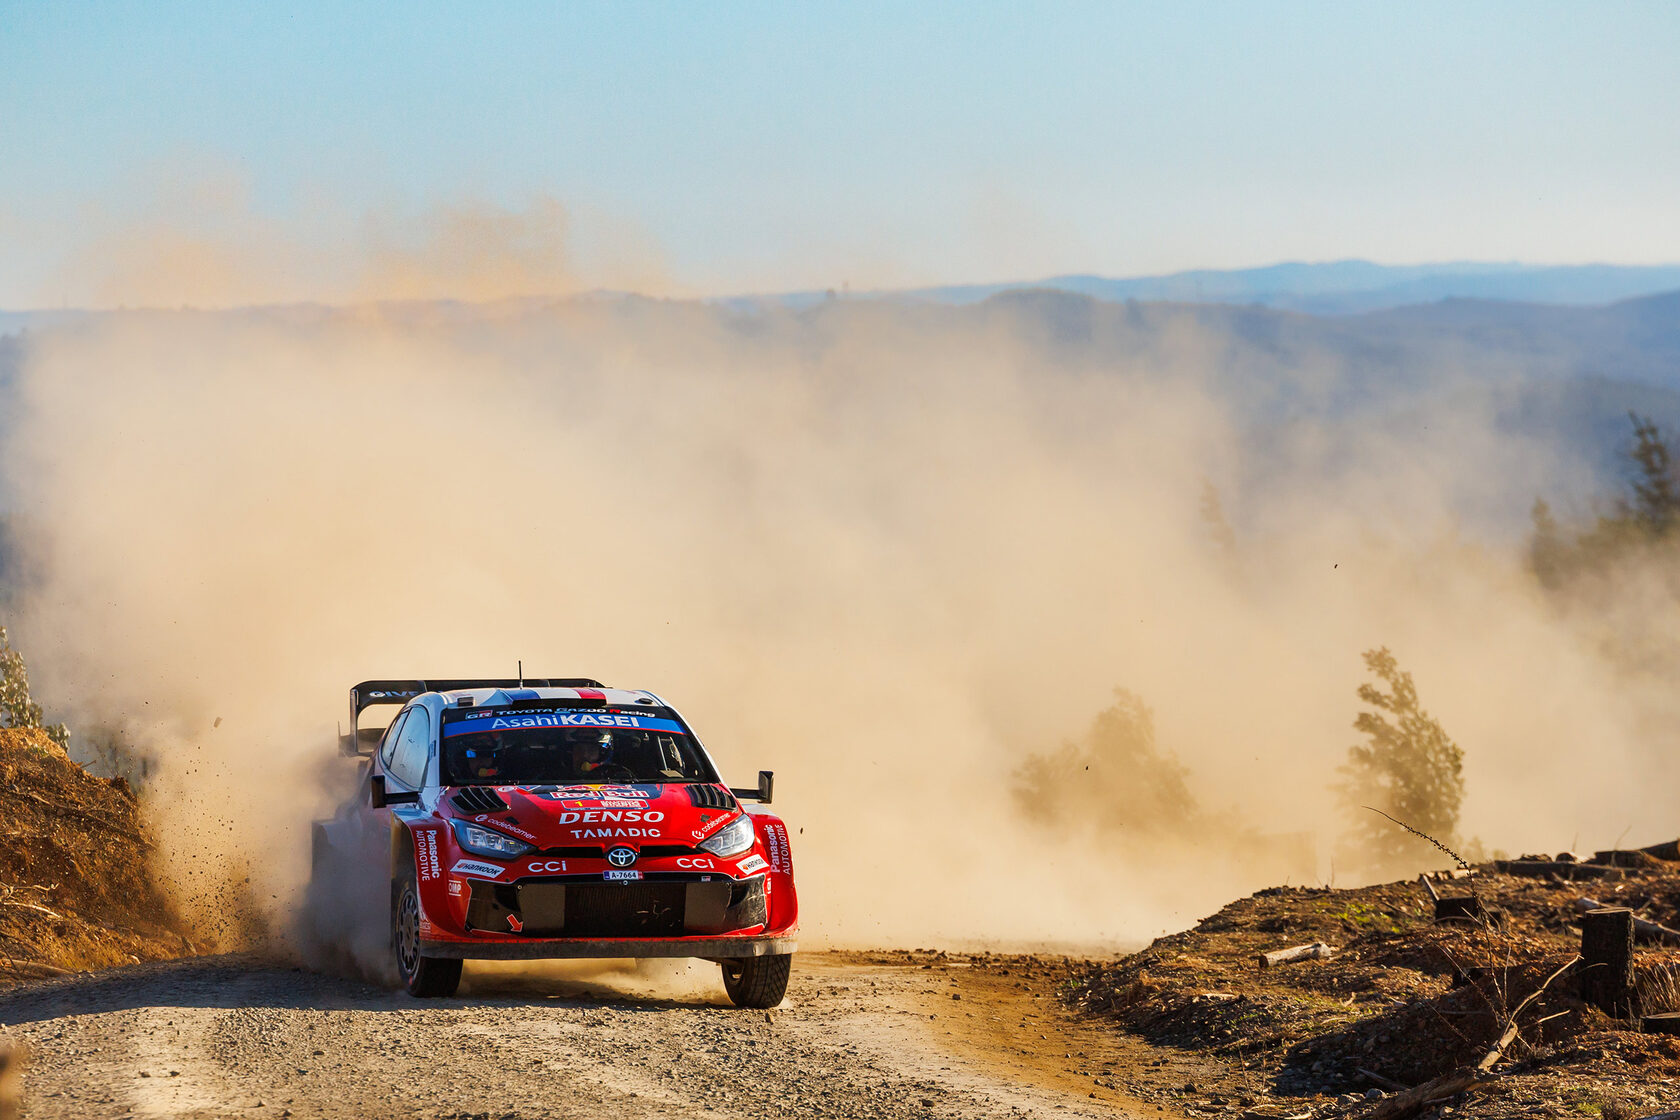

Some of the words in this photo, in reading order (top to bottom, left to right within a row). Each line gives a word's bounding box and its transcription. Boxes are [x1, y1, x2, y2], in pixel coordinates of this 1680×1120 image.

[496, 708, 553, 716] TOYOTA
[609, 708, 656, 718] Racing
[550, 790, 600, 799] Red
[600, 790, 650, 800] Bull
[559, 811, 665, 825] DENSO
[487, 818, 537, 840] codebeamer
[570, 828, 661, 839] TAMADIC
[416, 830, 430, 881] AUTOMOTIVE
[426, 829, 442, 879] Panasonic
[764, 824, 780, 873] Panasonic
[774, 824, 791, 875] AUTOMOTIVE
[611, 871, 637, 879] A-7664
[448, 882, 462, 893] OMP
